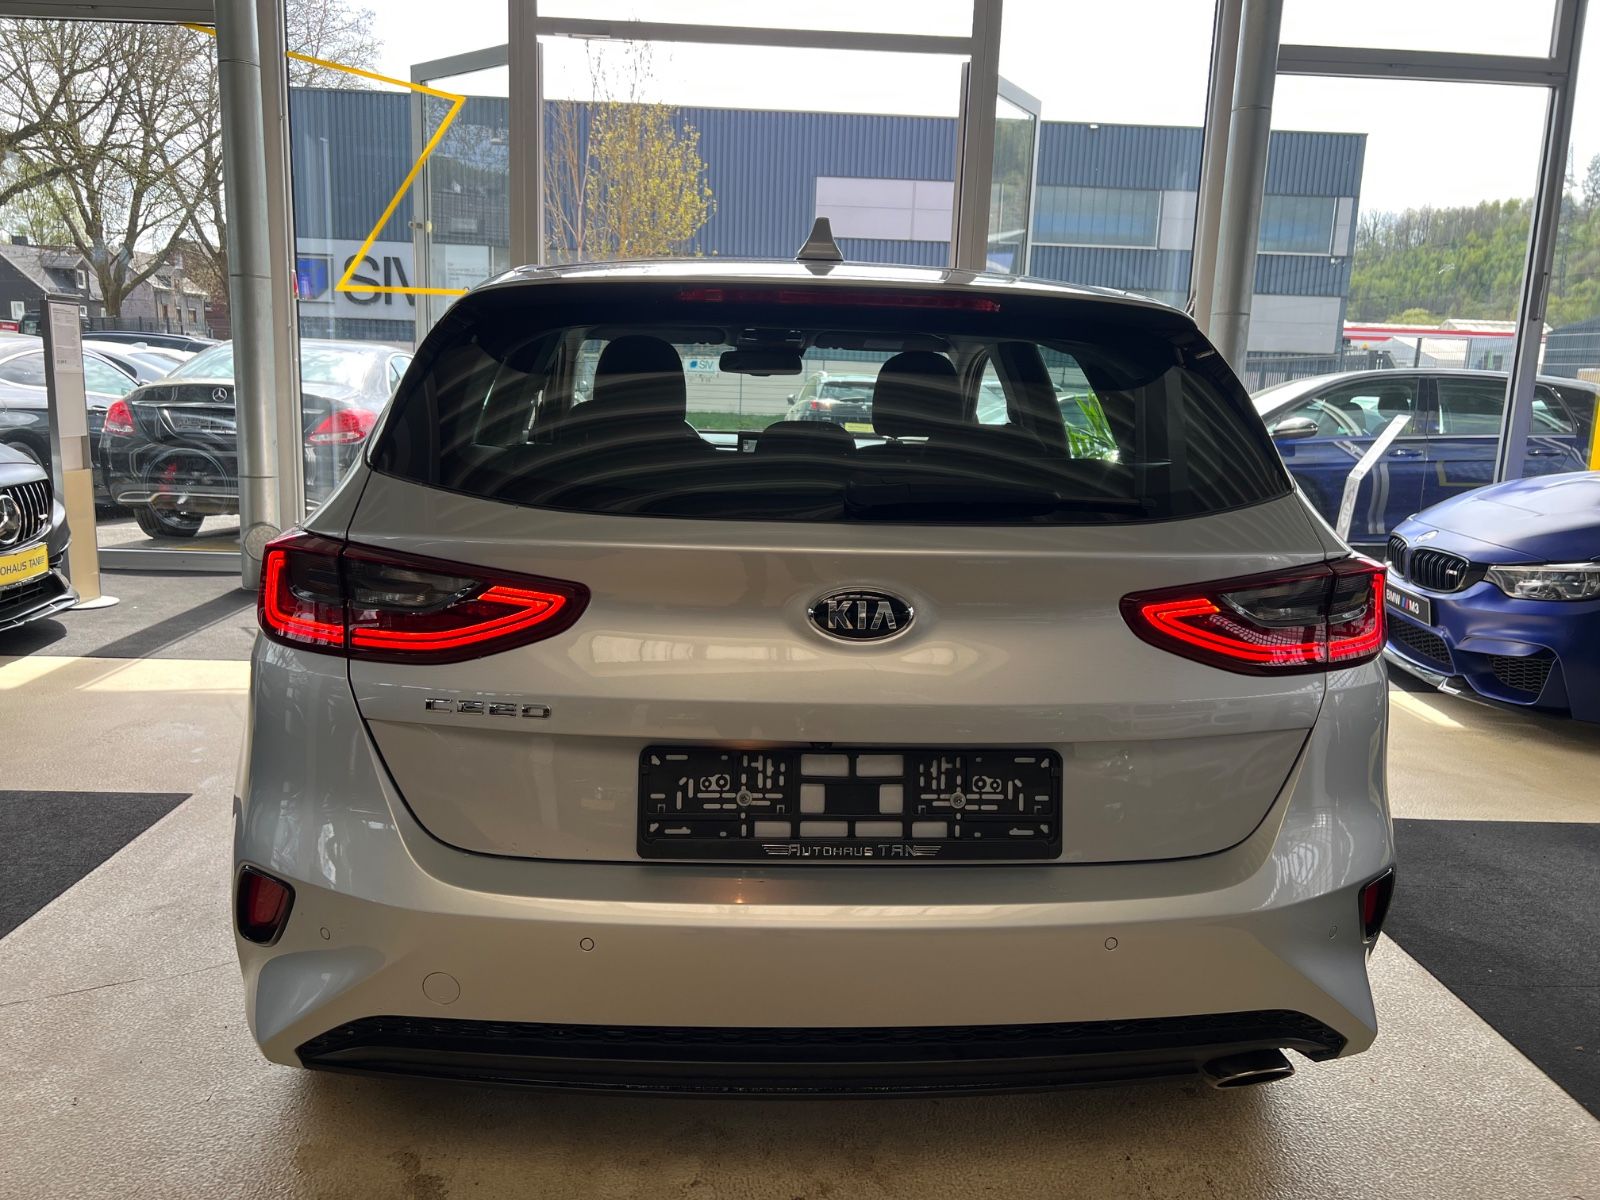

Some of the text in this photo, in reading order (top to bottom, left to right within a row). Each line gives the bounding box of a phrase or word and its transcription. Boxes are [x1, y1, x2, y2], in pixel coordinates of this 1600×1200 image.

[827, 600, 897, 629] KIA
[1386, 588, 1420, 615] BMW M3
[425, 698, 551, 718] CEED
